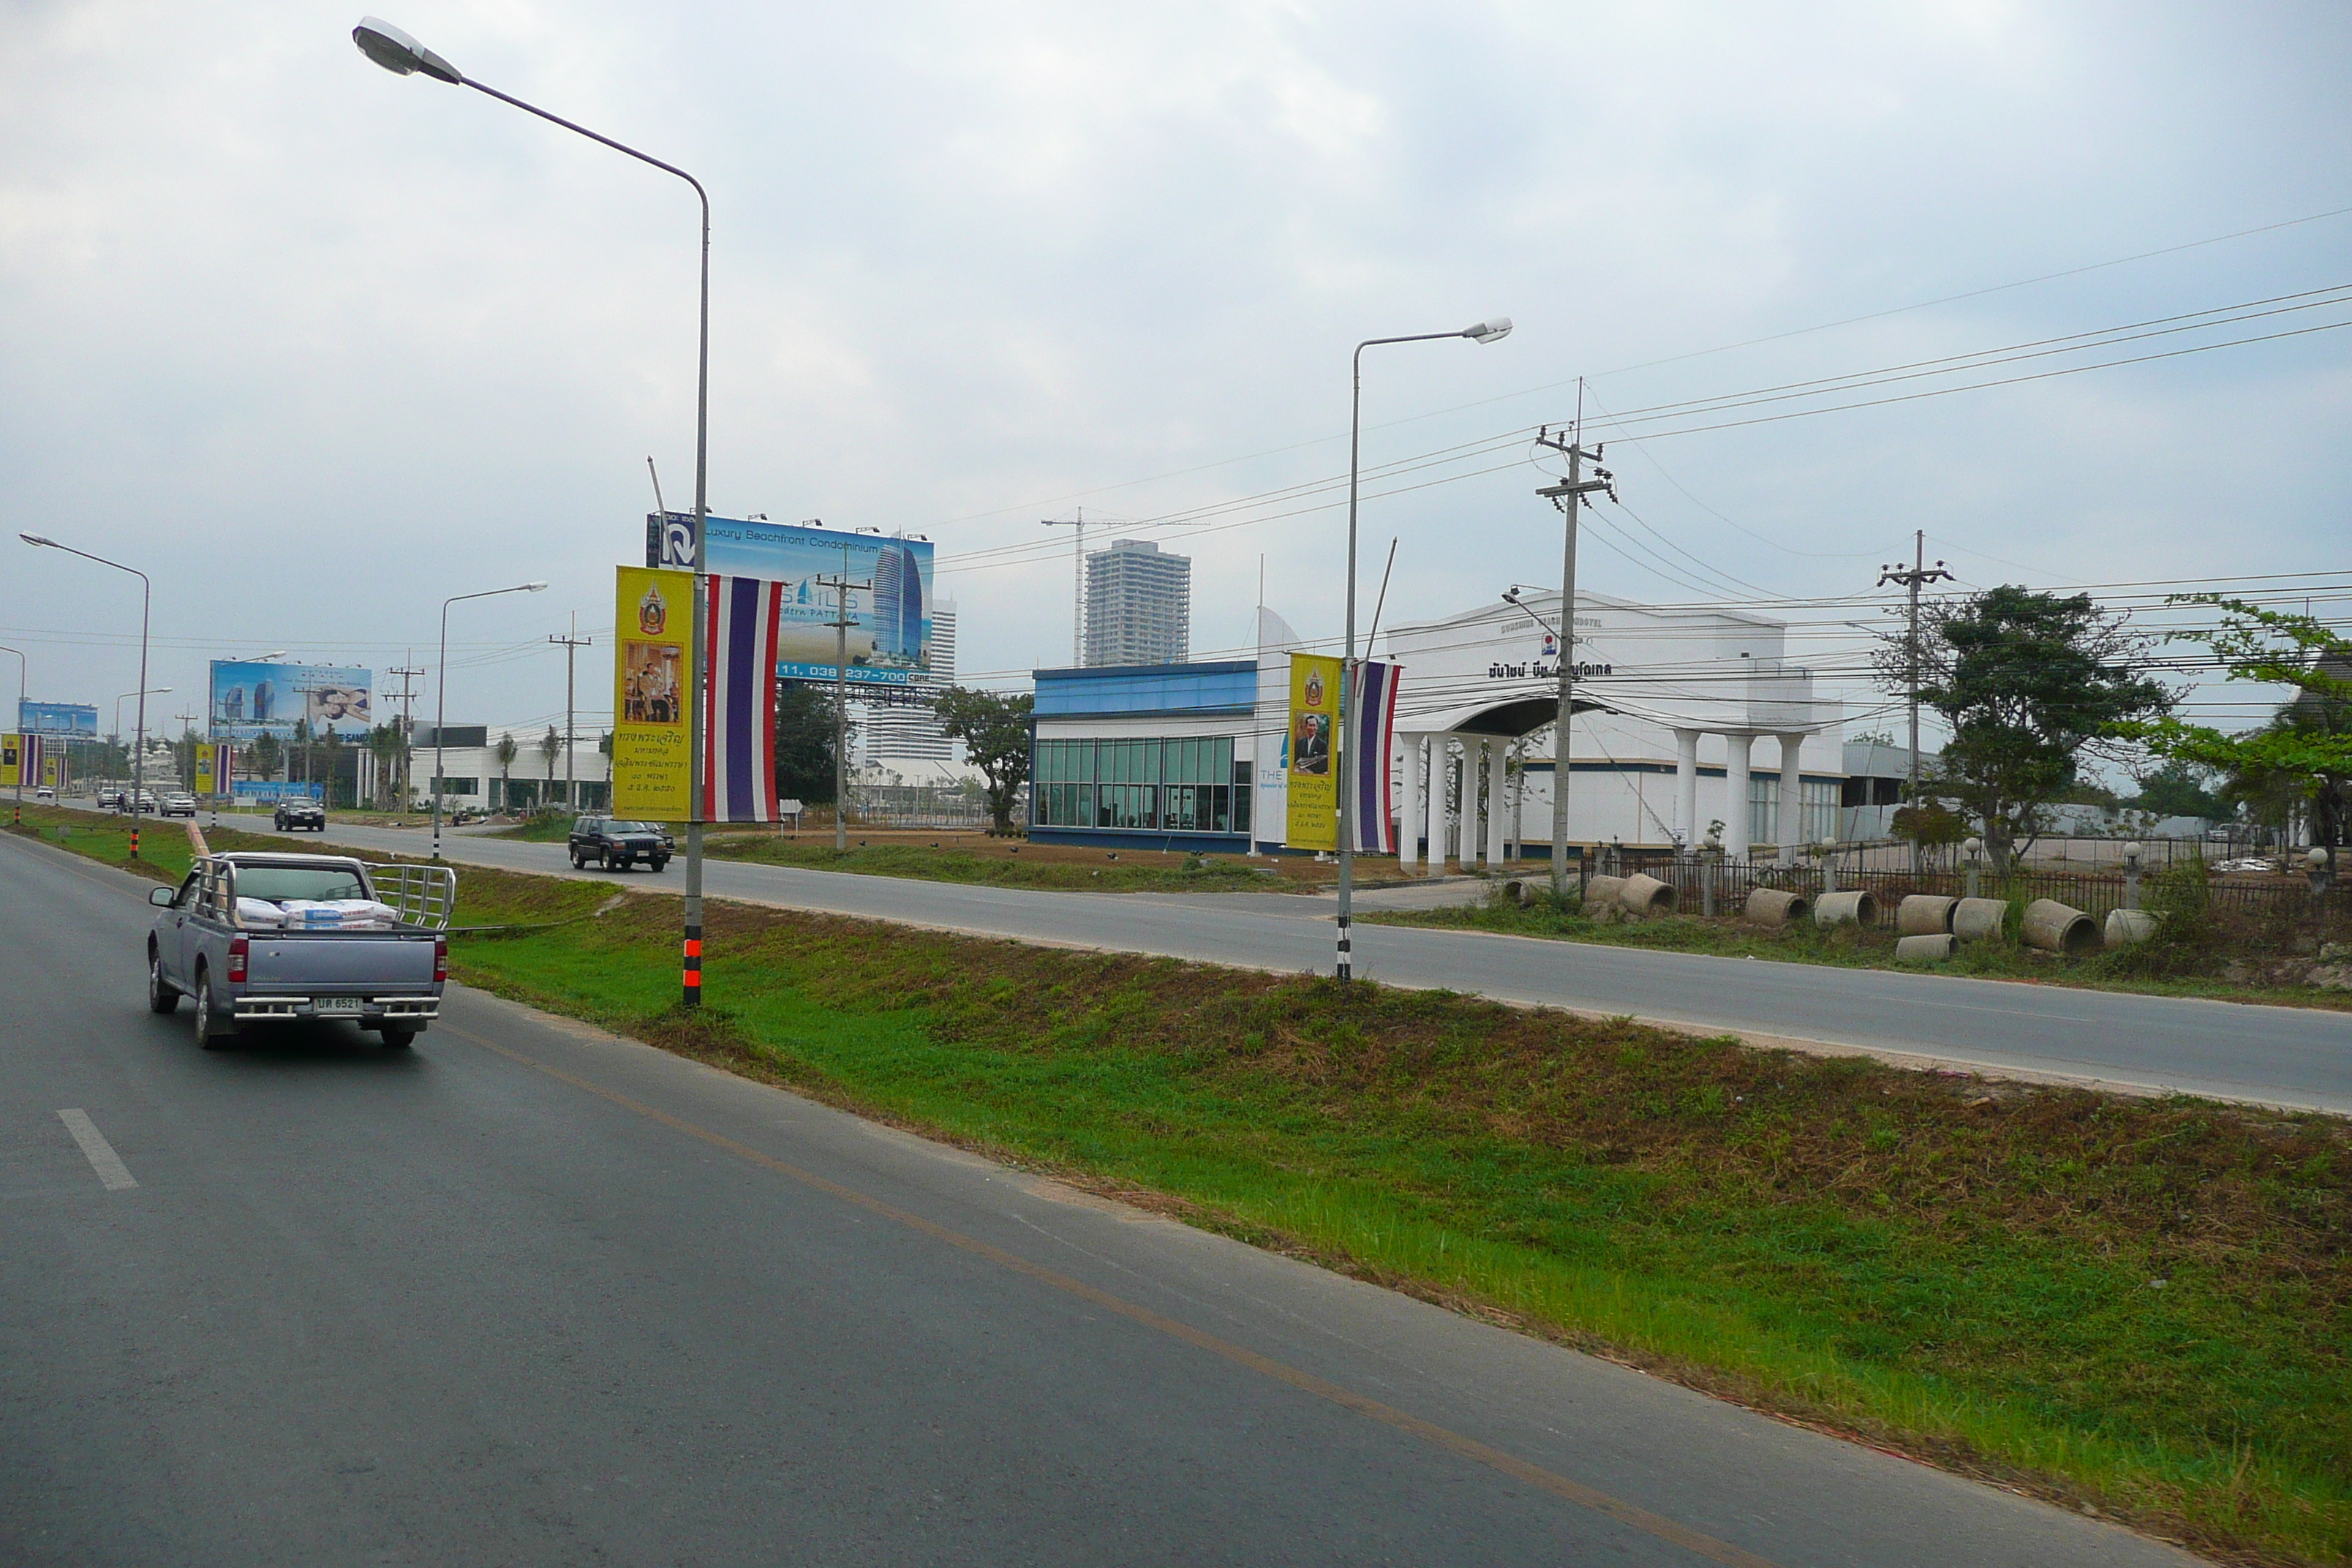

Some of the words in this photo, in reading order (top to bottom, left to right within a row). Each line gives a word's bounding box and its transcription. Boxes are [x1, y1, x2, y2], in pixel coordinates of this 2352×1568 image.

[746, 530, 805, 546] Beachfront
[810, 538, 878, 554] Condominium
[780, 606, 806, 616] odern
[810, 608, 858, 620] PATTYA
[1501, 619, 1534, 634] SUNSHINE
[1574, 617, 1602, 627] NDOTEL
[1556, 661, 1612, 676] นโดเทล
[618, 730, 685, 747] ทรงพระเจริญ
[1260, 770, 1282, 780] THE
[335, 999, 358, 1009] 6521
